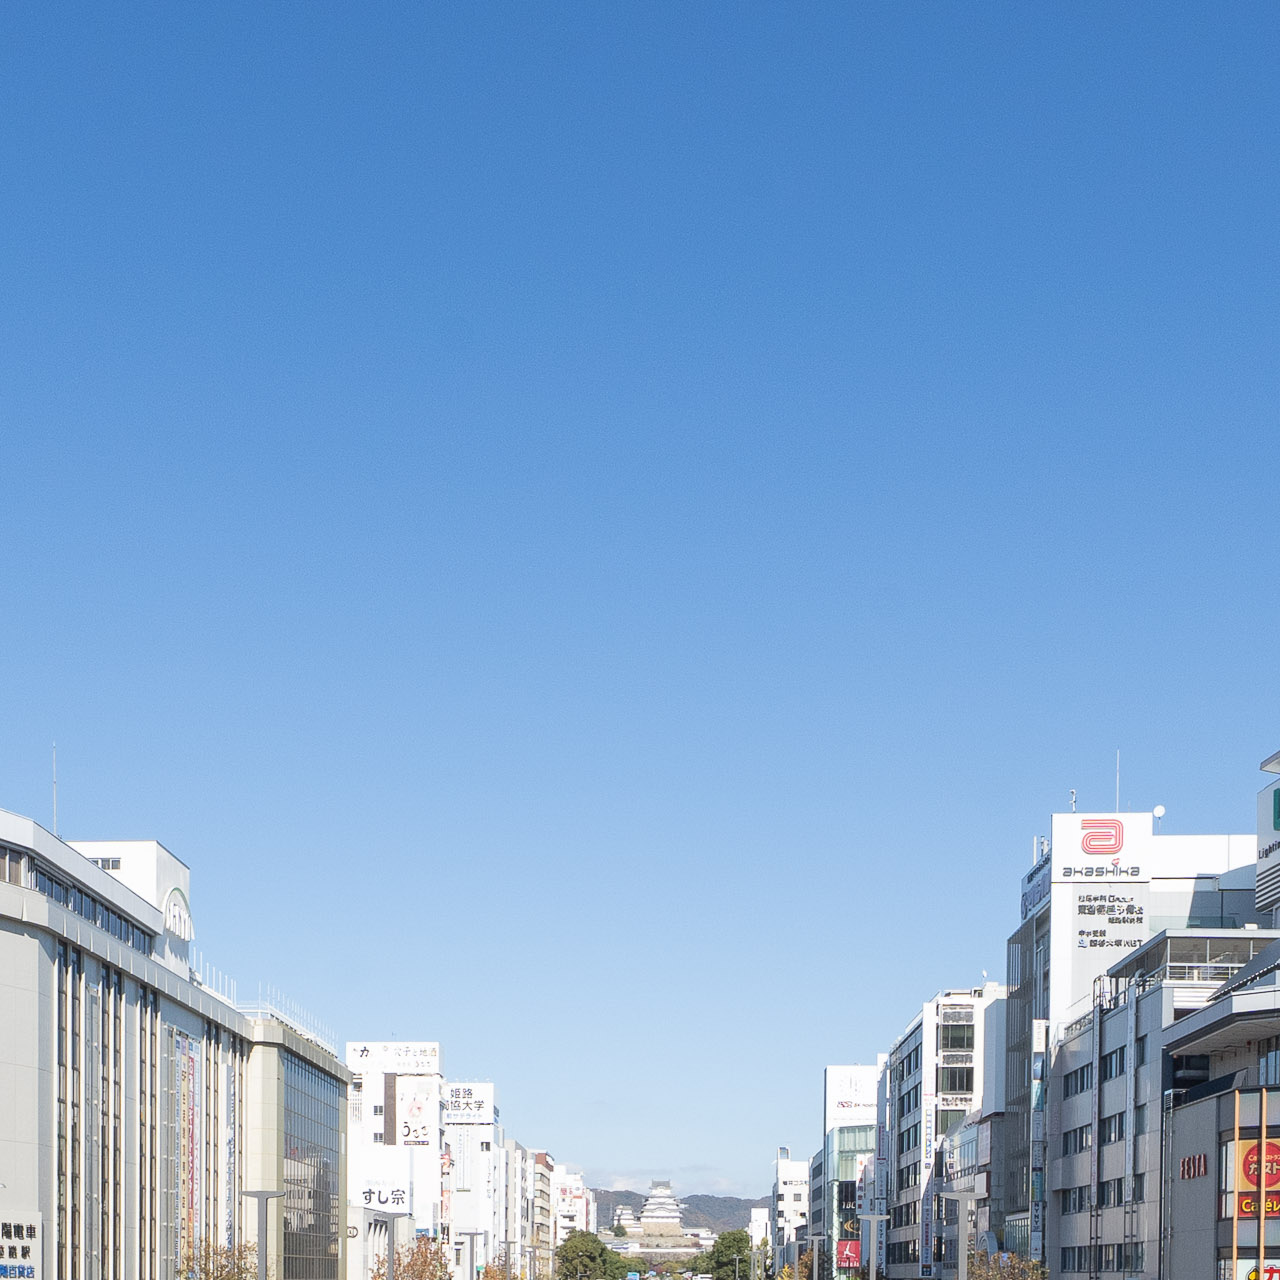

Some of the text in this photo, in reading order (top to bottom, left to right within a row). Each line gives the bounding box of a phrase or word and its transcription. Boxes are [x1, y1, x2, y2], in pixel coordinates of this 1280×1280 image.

[1062, 858, 1140, 877] akashika
[450, 1087, 473, 1099] 姫路
[1179, 1152, 1207, 1180] FESTA
[362, 1188, 406, 1206] すし宗
